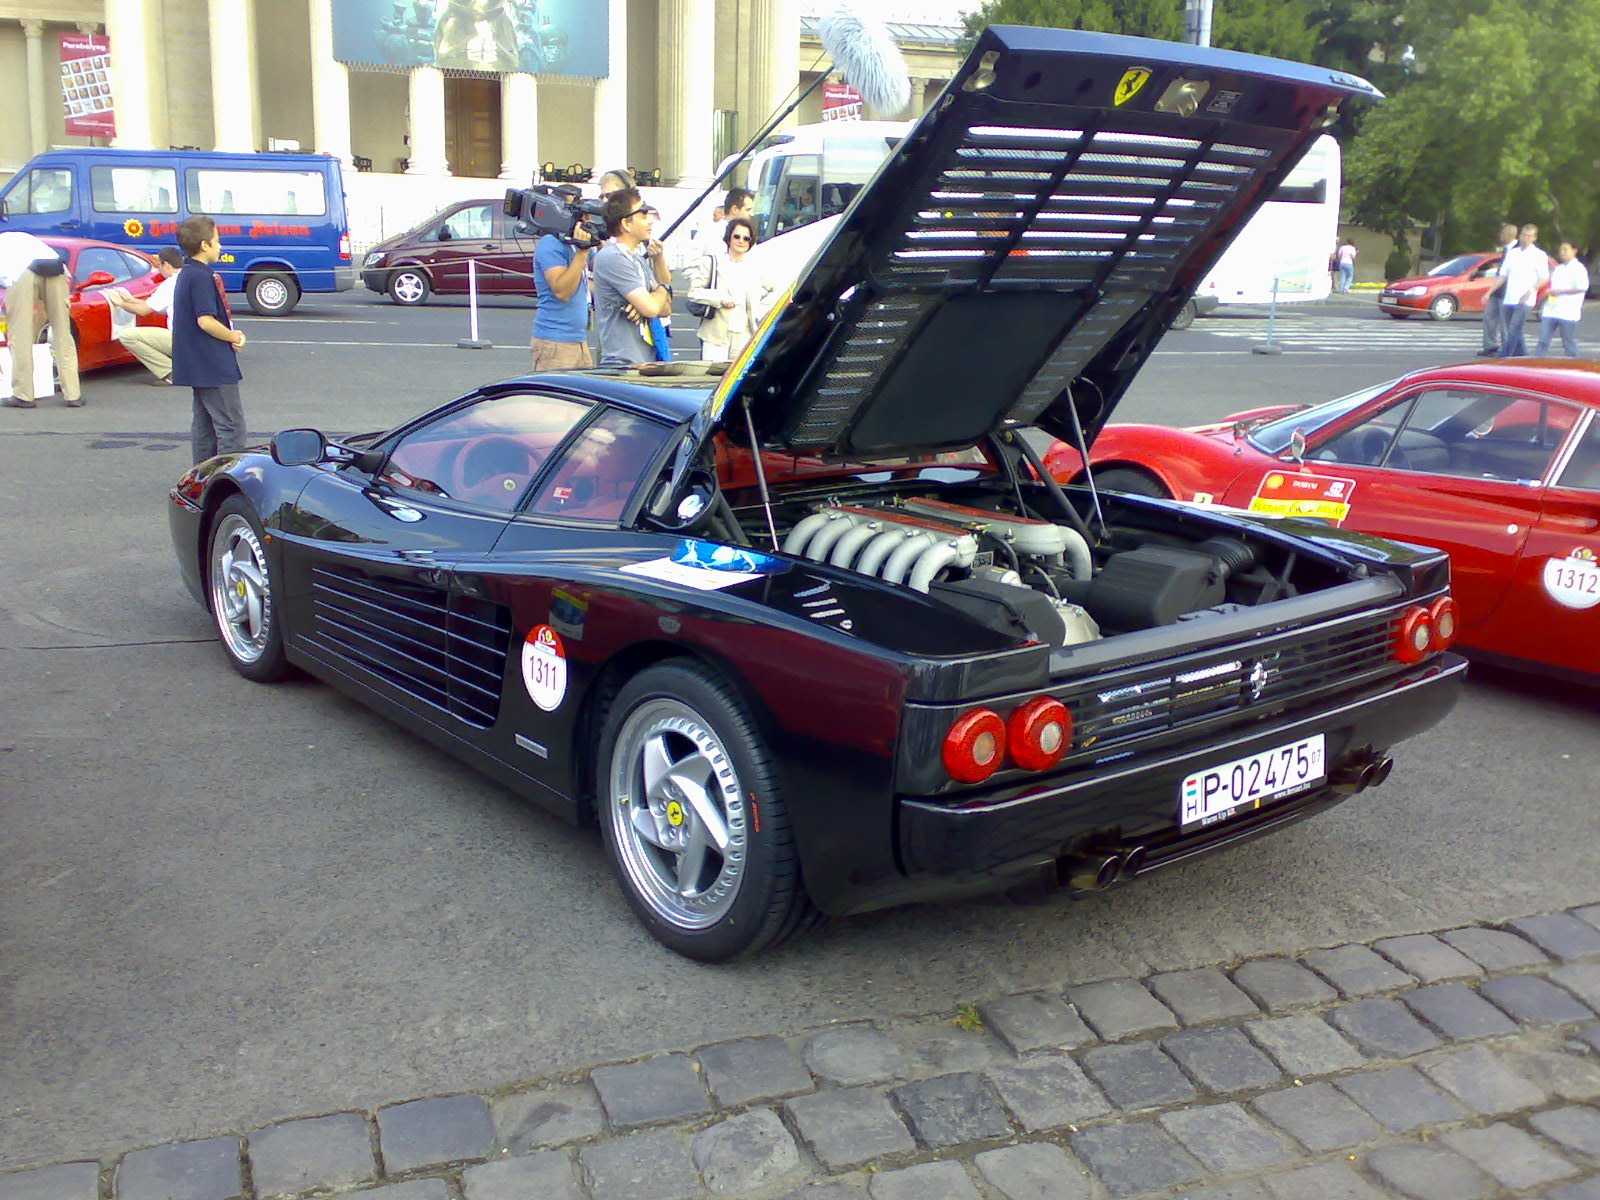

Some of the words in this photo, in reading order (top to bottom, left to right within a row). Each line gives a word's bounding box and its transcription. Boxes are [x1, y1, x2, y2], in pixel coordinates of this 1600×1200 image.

[1556, 567, 1598, 594] 1312
[529, 655, 557, 690] 1311
[1204, 743, 1309, 813] P-02475
[1187, 798, 1198, 818] H
